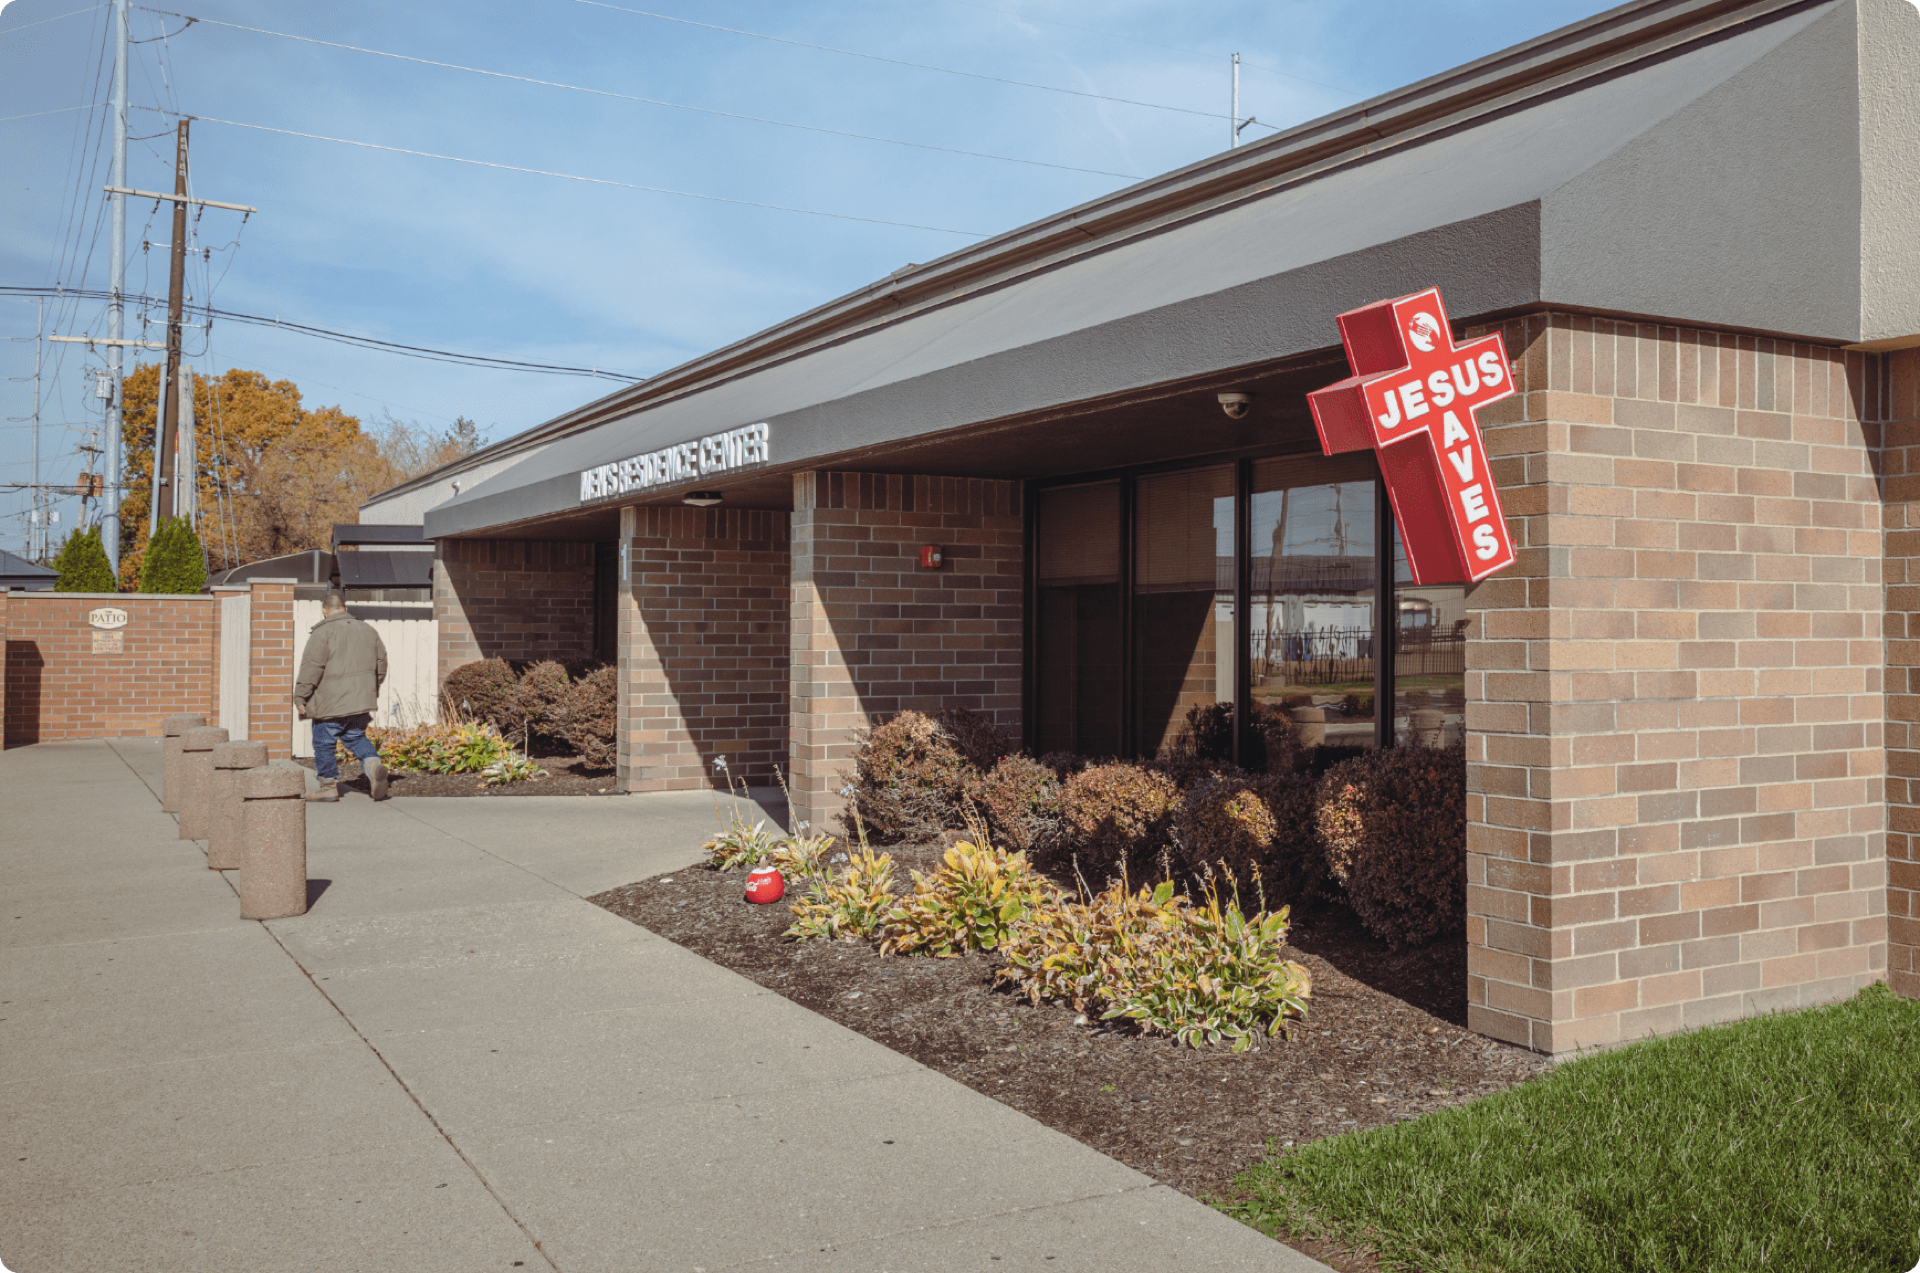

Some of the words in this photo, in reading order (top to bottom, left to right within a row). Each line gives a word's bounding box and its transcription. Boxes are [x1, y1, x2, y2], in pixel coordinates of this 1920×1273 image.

[1378, 351, 1504, 429] JESUS
[618, 441, 698, 493] RESIDENCE
[700, 422, 769, 475] CENTER
[91, 613, 126, 623] PATIO
